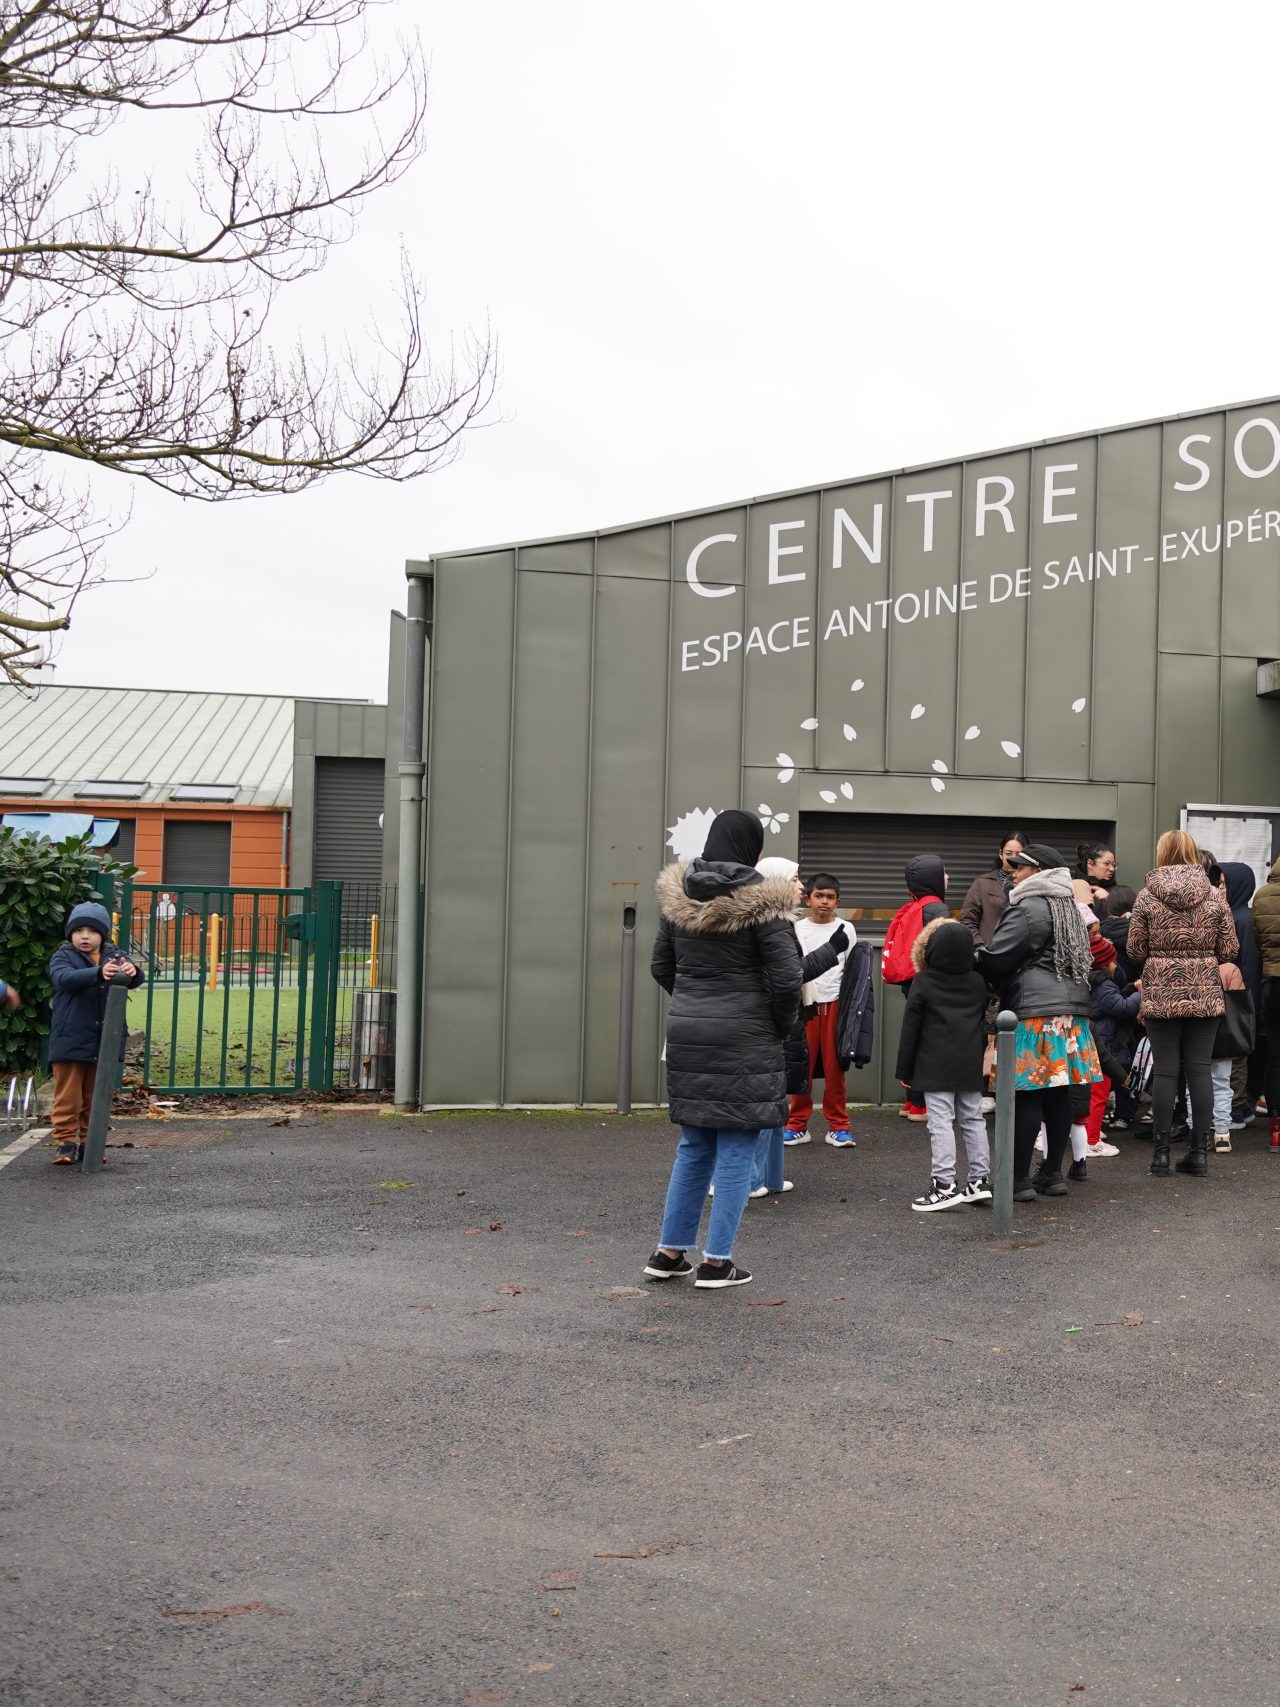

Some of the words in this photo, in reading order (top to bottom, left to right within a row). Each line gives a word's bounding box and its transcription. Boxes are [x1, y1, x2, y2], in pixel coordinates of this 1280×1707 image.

[685, 463, 1078, 598] CENTRE
[682, 617, 810, 672] ESPACE
[824, 581, 978, 641] ANTOINE
[989, 567, 1031, 603] DE
